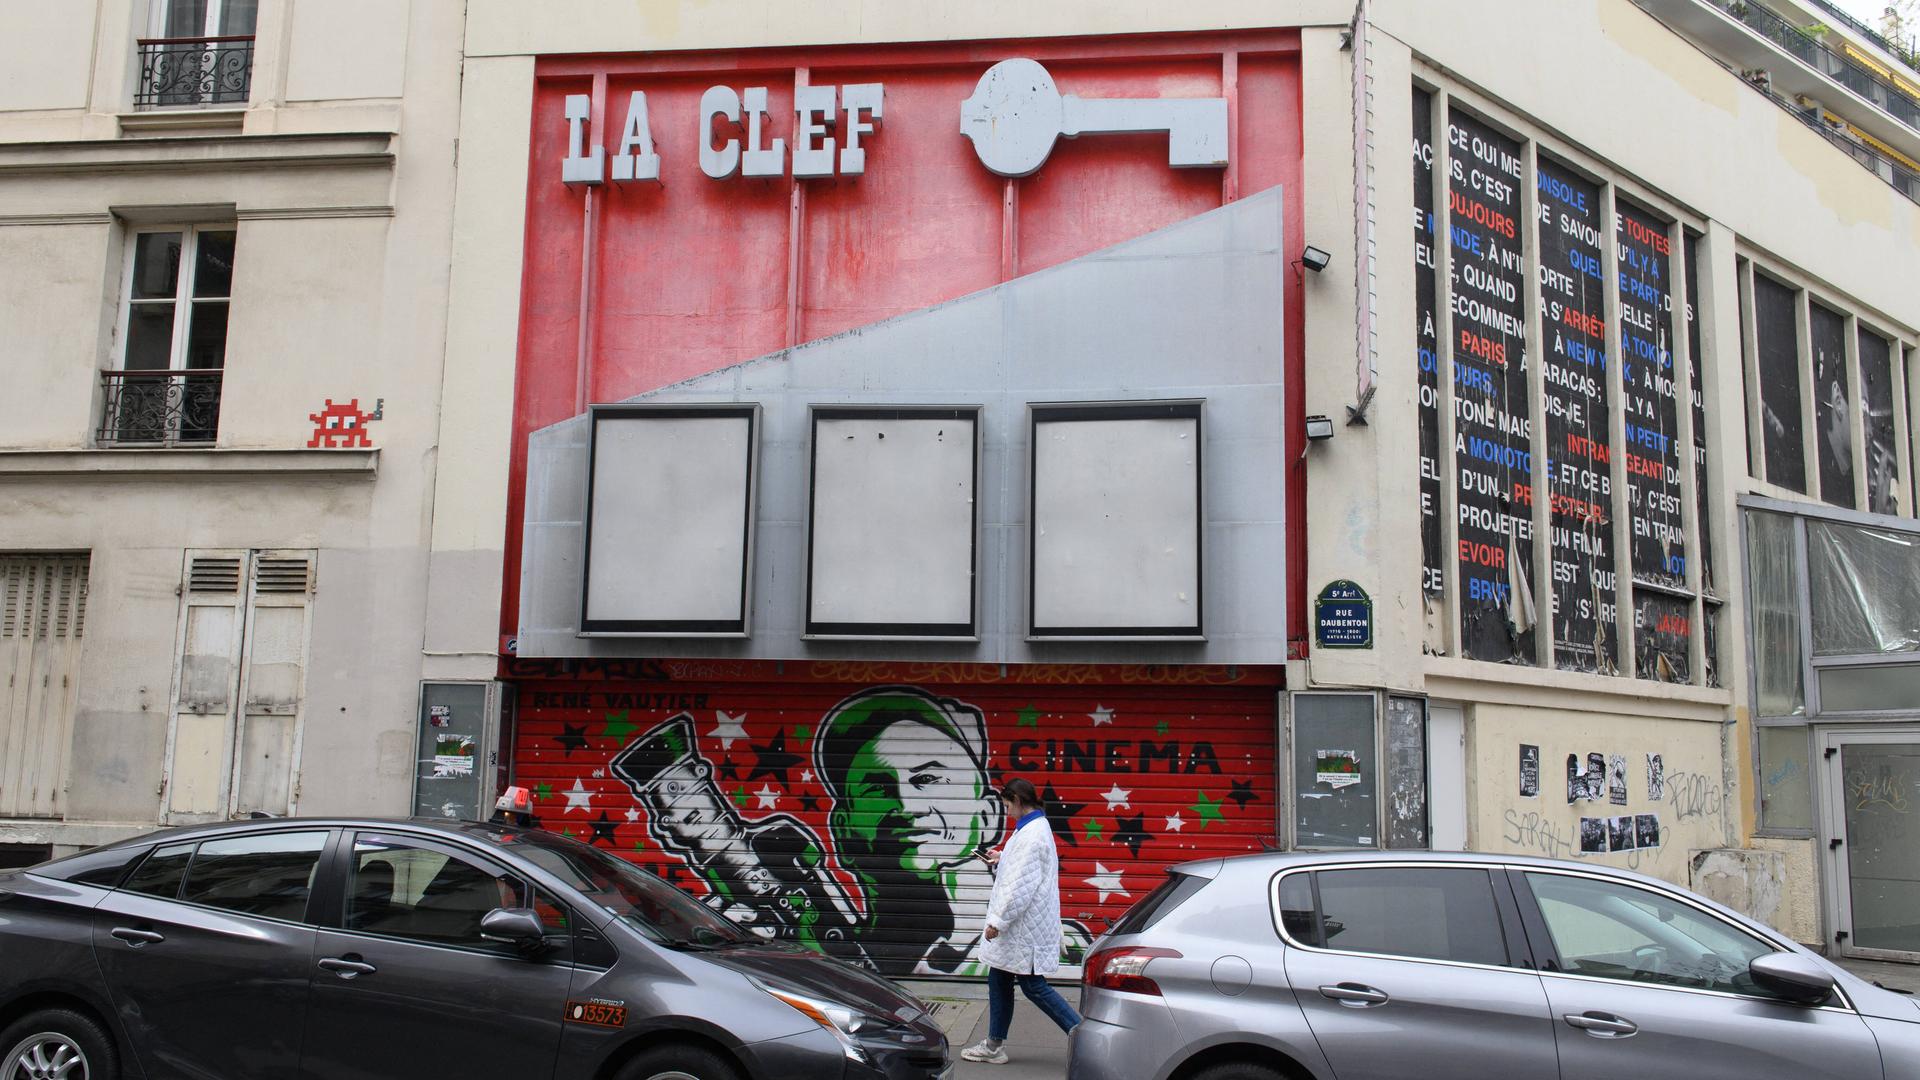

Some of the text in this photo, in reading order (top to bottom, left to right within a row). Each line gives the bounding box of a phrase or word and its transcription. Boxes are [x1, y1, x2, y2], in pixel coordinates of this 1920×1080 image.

[562, 82, 884, 185] LA CLEF
[1448, 124, 1670, 255] CE QUI ME ONSOLE, E TOUTES
[1471, 169, 1512, 205] C'EST
[1618, 242, 1639, 270] U'IL
[1414, 207, 1424, 230] E
[1488, 238, 1499, 264] À
[1619, 302, 1653, 332] ELLE
[1450, 191, 1515, 239] OUJOURS
[1631, 277, 1662, 312] PART,
[1451, 292, 1524, 340] ECOMMEN
[1554, 329, 1564, 355] À
[1566, 338, 1597, 367] NEW
[1644, 366, 1653, 390] À
[1463, 264, 1516, 303] QUAND
[1541, 297, 1549, 317] A
[1551, 301, 1605, 341] S'ARRÊT
[1632, 337, 1672, 369] TOKO
[1423, 310, 1435, 338] À
[1461, 329, 1508, 371] PARIS,
[1544, 361, 1602, 403] ARACAS;
[1636, 396, 1643, 416] Y
[1646, 401, 1655, 420] A
[1455, 432, 1467, 455] A
[1561, 463, 1578, 486] ET
[1581, 469, 1599, 493] CE
[1648, 490, 1680, 515] C'EST
[1626, 423, 1635, 442] N
[1637, 424, 1669, 455] PETIT
[1421, 492, 1434, 517] E
[1550, 526, 1569, 549] UN
[1462, 468, 1499, 498] D'UN
[1634, 516, 1650, 538] EN
[1459, 538, 1505, 569] EVOIR
[1553, 559, 1580, 585] EST
[1320, 619, 1368, 627] DAUBENTON
[1335, 609, 1353, 617] RUE
[604, 691, 710, 710] VAUTIER
[1009, 738, 1223, 775] CINEMA
[583, 1004, 624, 1025] 13573
